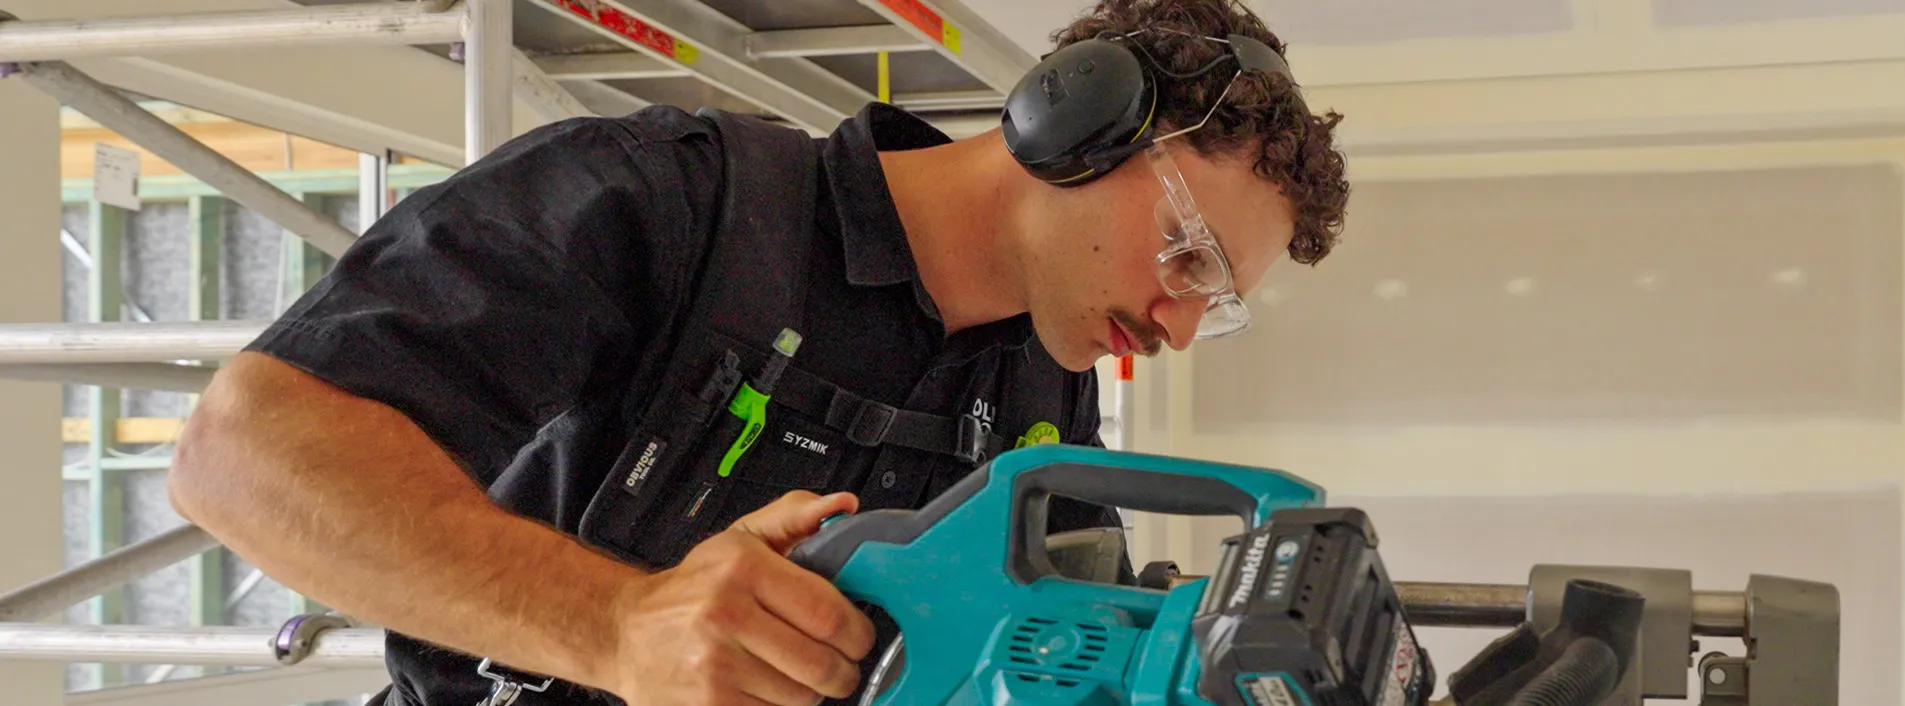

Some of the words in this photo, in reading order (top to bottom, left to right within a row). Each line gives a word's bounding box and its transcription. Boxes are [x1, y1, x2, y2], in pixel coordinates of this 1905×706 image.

[626, 442, 657, 486] OBVIOUS
[783, 431, 829, 455] SYZMIK
[1229, 533, 1269, 607] makita
